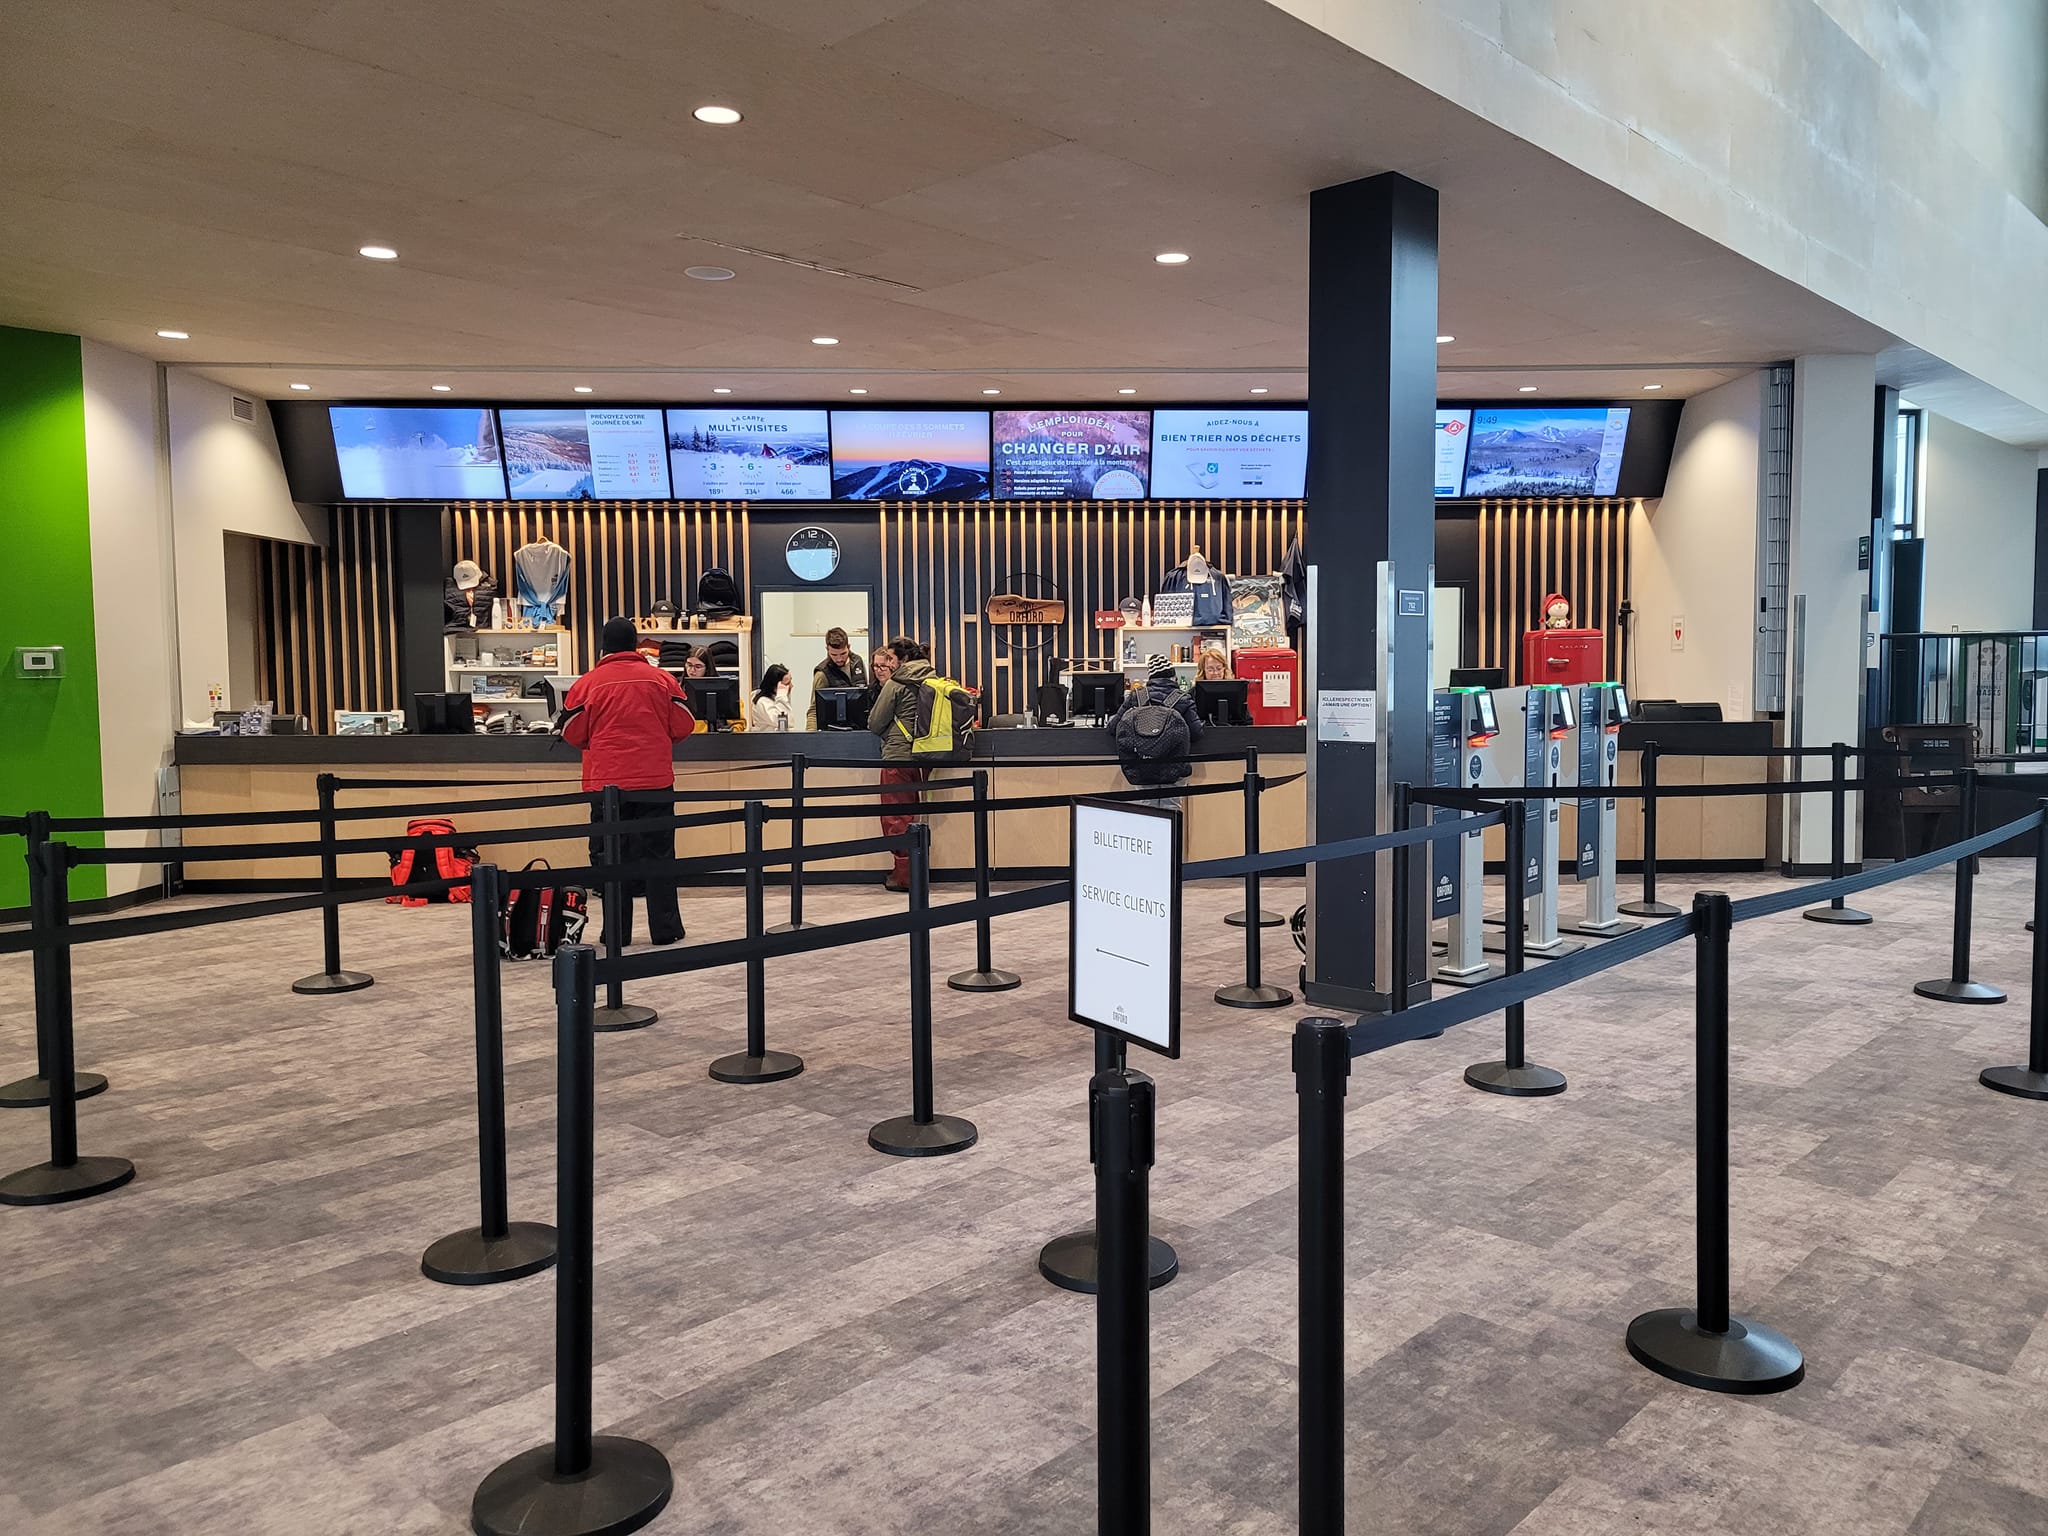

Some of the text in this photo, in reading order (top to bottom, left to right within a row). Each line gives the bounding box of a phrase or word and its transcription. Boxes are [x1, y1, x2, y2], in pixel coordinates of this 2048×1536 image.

[742, 415, 765, 423] CARTE
[1206, 419, 1253, 427] AIDEZ-NOUS
[1477, 415, 1498, 425] 9:49
[708, 424, 788, 432] MULTI-VISITES
[1027, 415, 1117, 433] L'EMPLOI IDÉAL
[1161, 433, 1301, 442] BIEN TRIER NOS DÉCHETS
[1002, 443, 1141, 456] CHANGER D'AIR
[710, 463, 717, 471] 3
[747, 463, 754, 471] 6
[784, 463, 792, 471] 9
[1106, 459, 1137, 467] montagne
[808, 530, 818, 539] 12
[1009, 611, 1044, 623] ORFORD
[1093, 830, 1153, 856] BILLETTERIE
[1436, 883, 1453, 898] ORFORD
[1081, 884, 1166, 919] SERVICE CLIENTS
[1112, 1010, 1128, 1025] ORFORD
